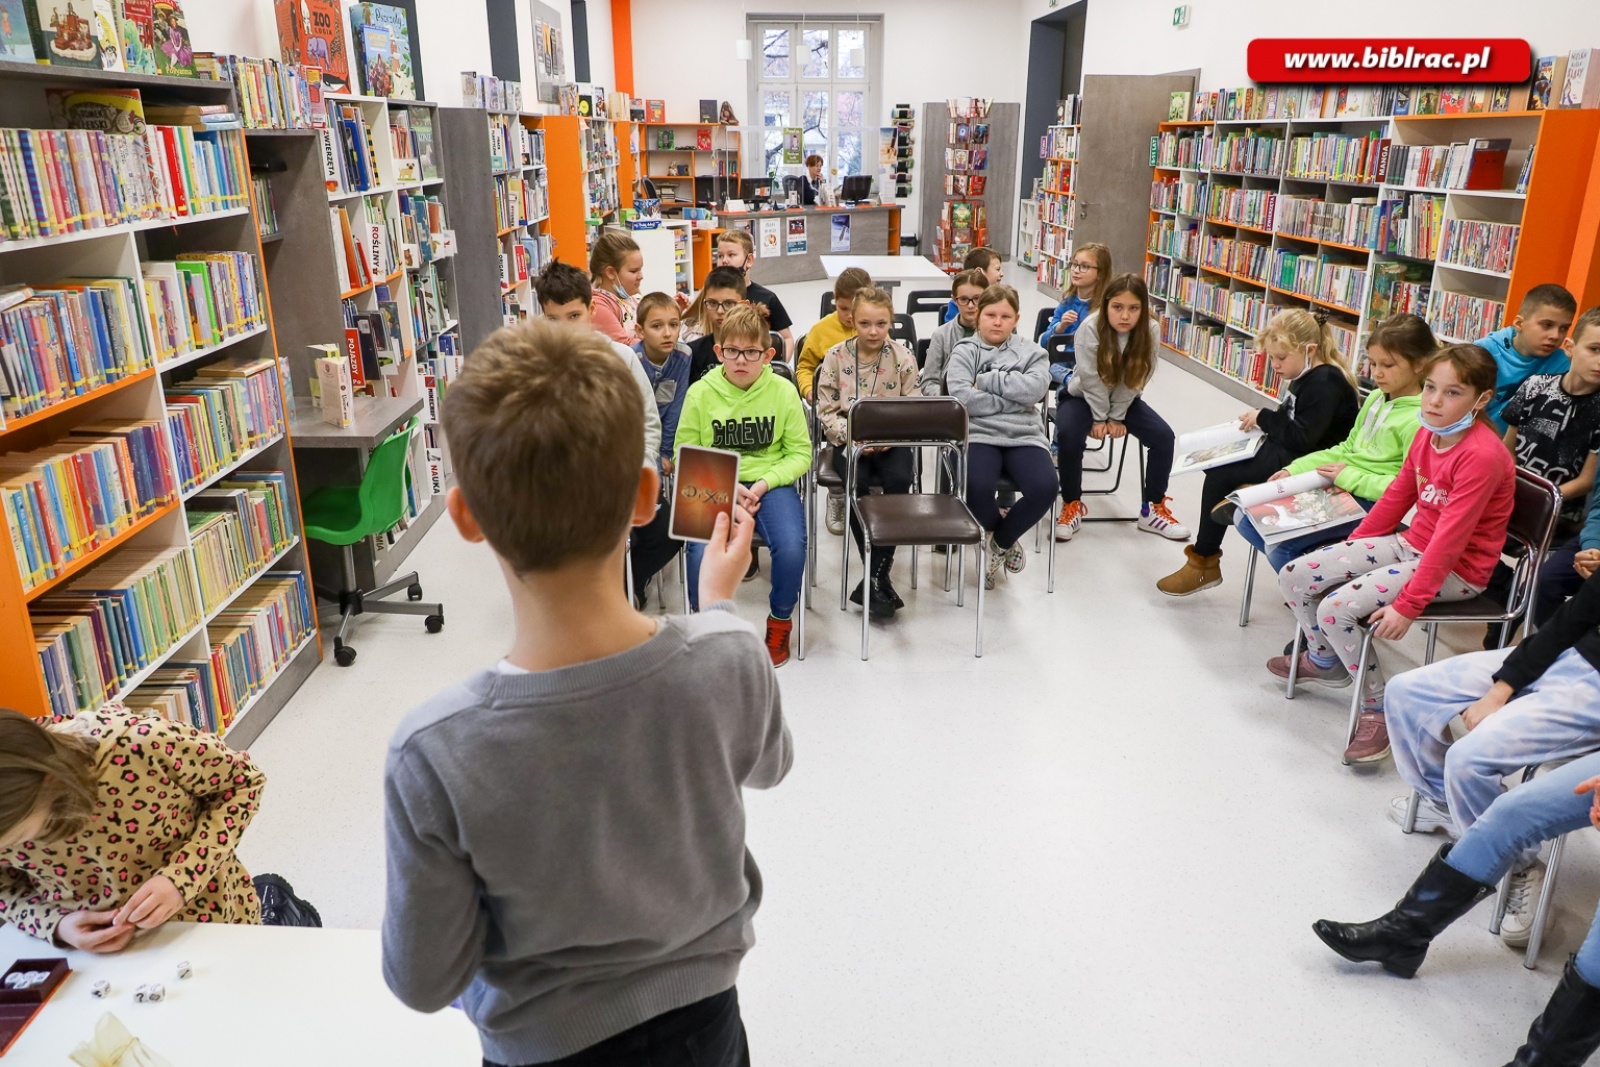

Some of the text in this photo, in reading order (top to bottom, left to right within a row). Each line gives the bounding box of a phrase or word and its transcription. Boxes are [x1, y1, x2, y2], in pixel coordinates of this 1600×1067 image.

[312, 11, 331, 29] ZOO
[323, 129, 336, 176] ZWIERZĘTA
[1378, 145, 1389, 177] MANGA
[1369, 212, 1380, 244] KOMIKSY
[371, 225, 381, 268] ROŚLINY
[348, 337, 359, 376] POJAZDY
[711, 415, 775, 446] CREW
[430, 464, 441, 494] NAUKA
